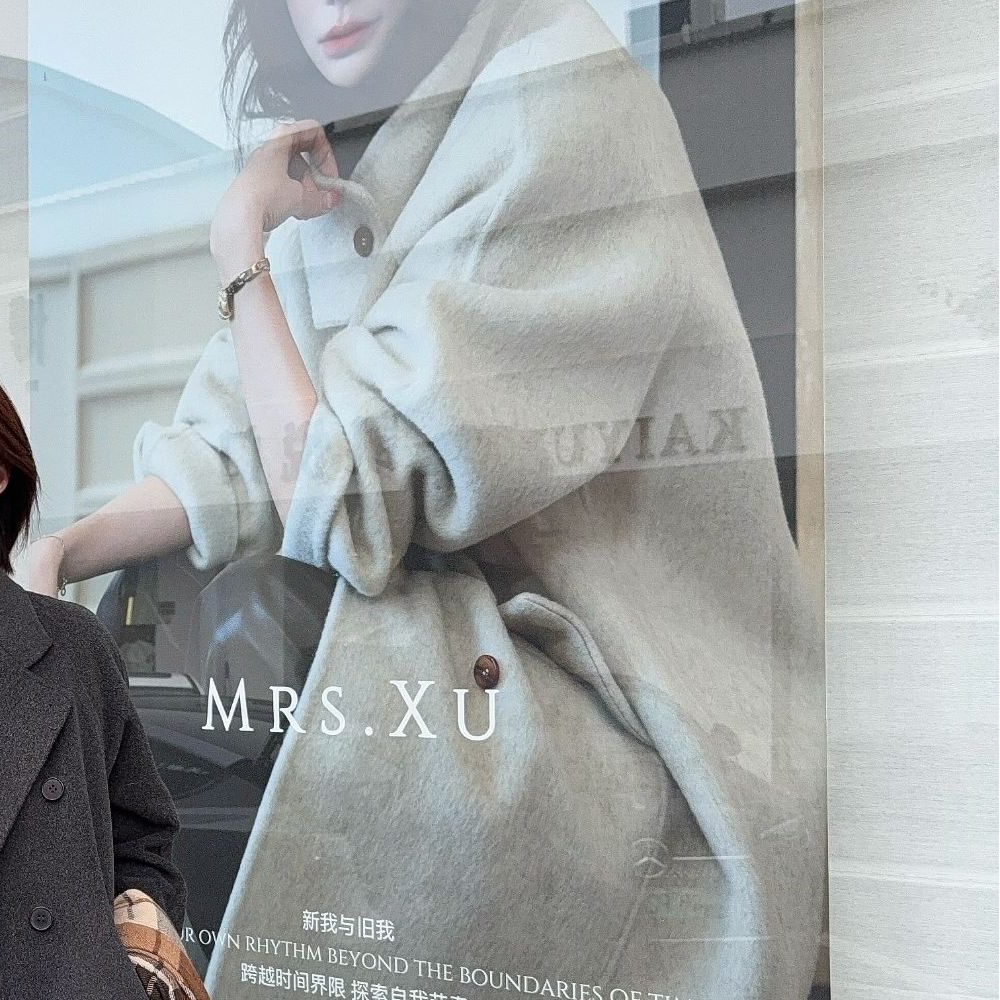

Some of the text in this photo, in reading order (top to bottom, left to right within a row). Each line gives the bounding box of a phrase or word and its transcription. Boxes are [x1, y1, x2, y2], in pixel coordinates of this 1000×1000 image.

[302, 909, 395, 942] 新我与旧我
[199, 929, 240, 949] OWN
[246, 935, 322, 962] RHYTHM
[328, 947, 409, 975] BEYOND
[414, 959, 454, 982] THE
[241, 963, 346, 999] 跨越时间界限
